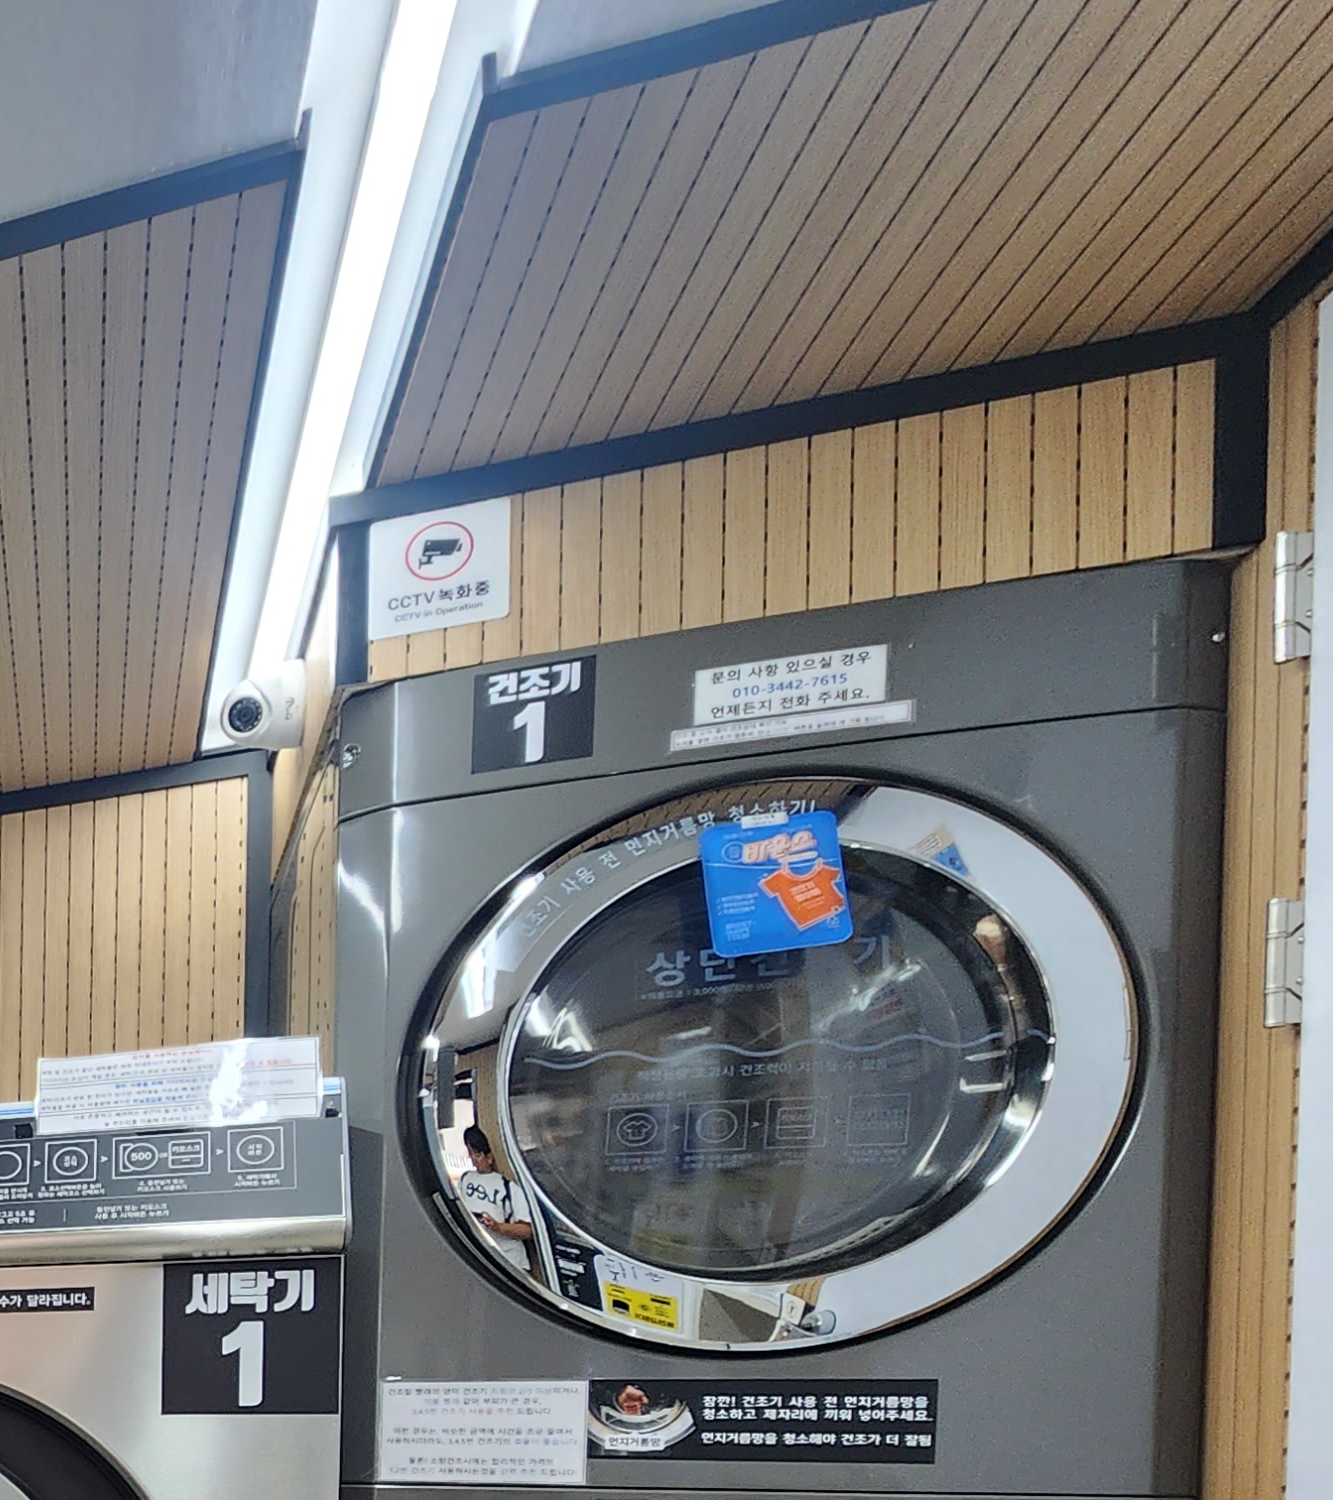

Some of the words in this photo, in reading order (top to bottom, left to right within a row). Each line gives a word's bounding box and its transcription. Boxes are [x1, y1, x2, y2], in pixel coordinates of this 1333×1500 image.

[388, 591, 435, 611] CCTV
[438, 580, 490, 602] 녹화중
[435, 602, 483, 616] Operation
[711, 668, 741, 684] 문의
[748, 664, 779, 679] 사항
[786, 655, 832, 674] 있으실
[840, 651, 872, 667] 경우
[488, 661, 581, 705] 건조기
[732, 672, 848, 698] 010-3442-7615
[711, 699, 772, 719] 언제든지
[779, 694, 810, 709] 전화
[818, 688, 870, 703] 주세요.
[513, 700, 545, 763] 1
[560, 866, 597, 896] 사용
[599, 850, 622, 870] 전
[131, 1151, 152, 1161] 500
[27, 1293, 91, 1307] 달라집니다.
[185, 1269, 315, 1315] 세탁기
[221, 1320, 264, 1407] 1
[702, 1396, 736, 1409] 잠깐!
[742, 1396, 784, 1408] 건조기
[789, 1396, 818, 1408] 사용
[824, 1396, 838, 1408] 전
[844, 1395, 929, 1409] 먼지거름망을
[702, 1409, 757, 1421] 청소하고
[763, 1409, 818, 1421] 제자리에
[824, 1409, 852, 1421] 끼워
[858, 1409, 933, 1422] 넣어주세요.
[607, 1436, 661, 1448] 먼지거름망
[701, 1432, 778, 1445] 먼지거름망을
[783, 1433, 836, 1445] 청소해야
[841, 1433, 882, 1446] 건조가
[886, 1433, 899, 1446] 더
[904, 1434, 932, 1447] 잘됨
